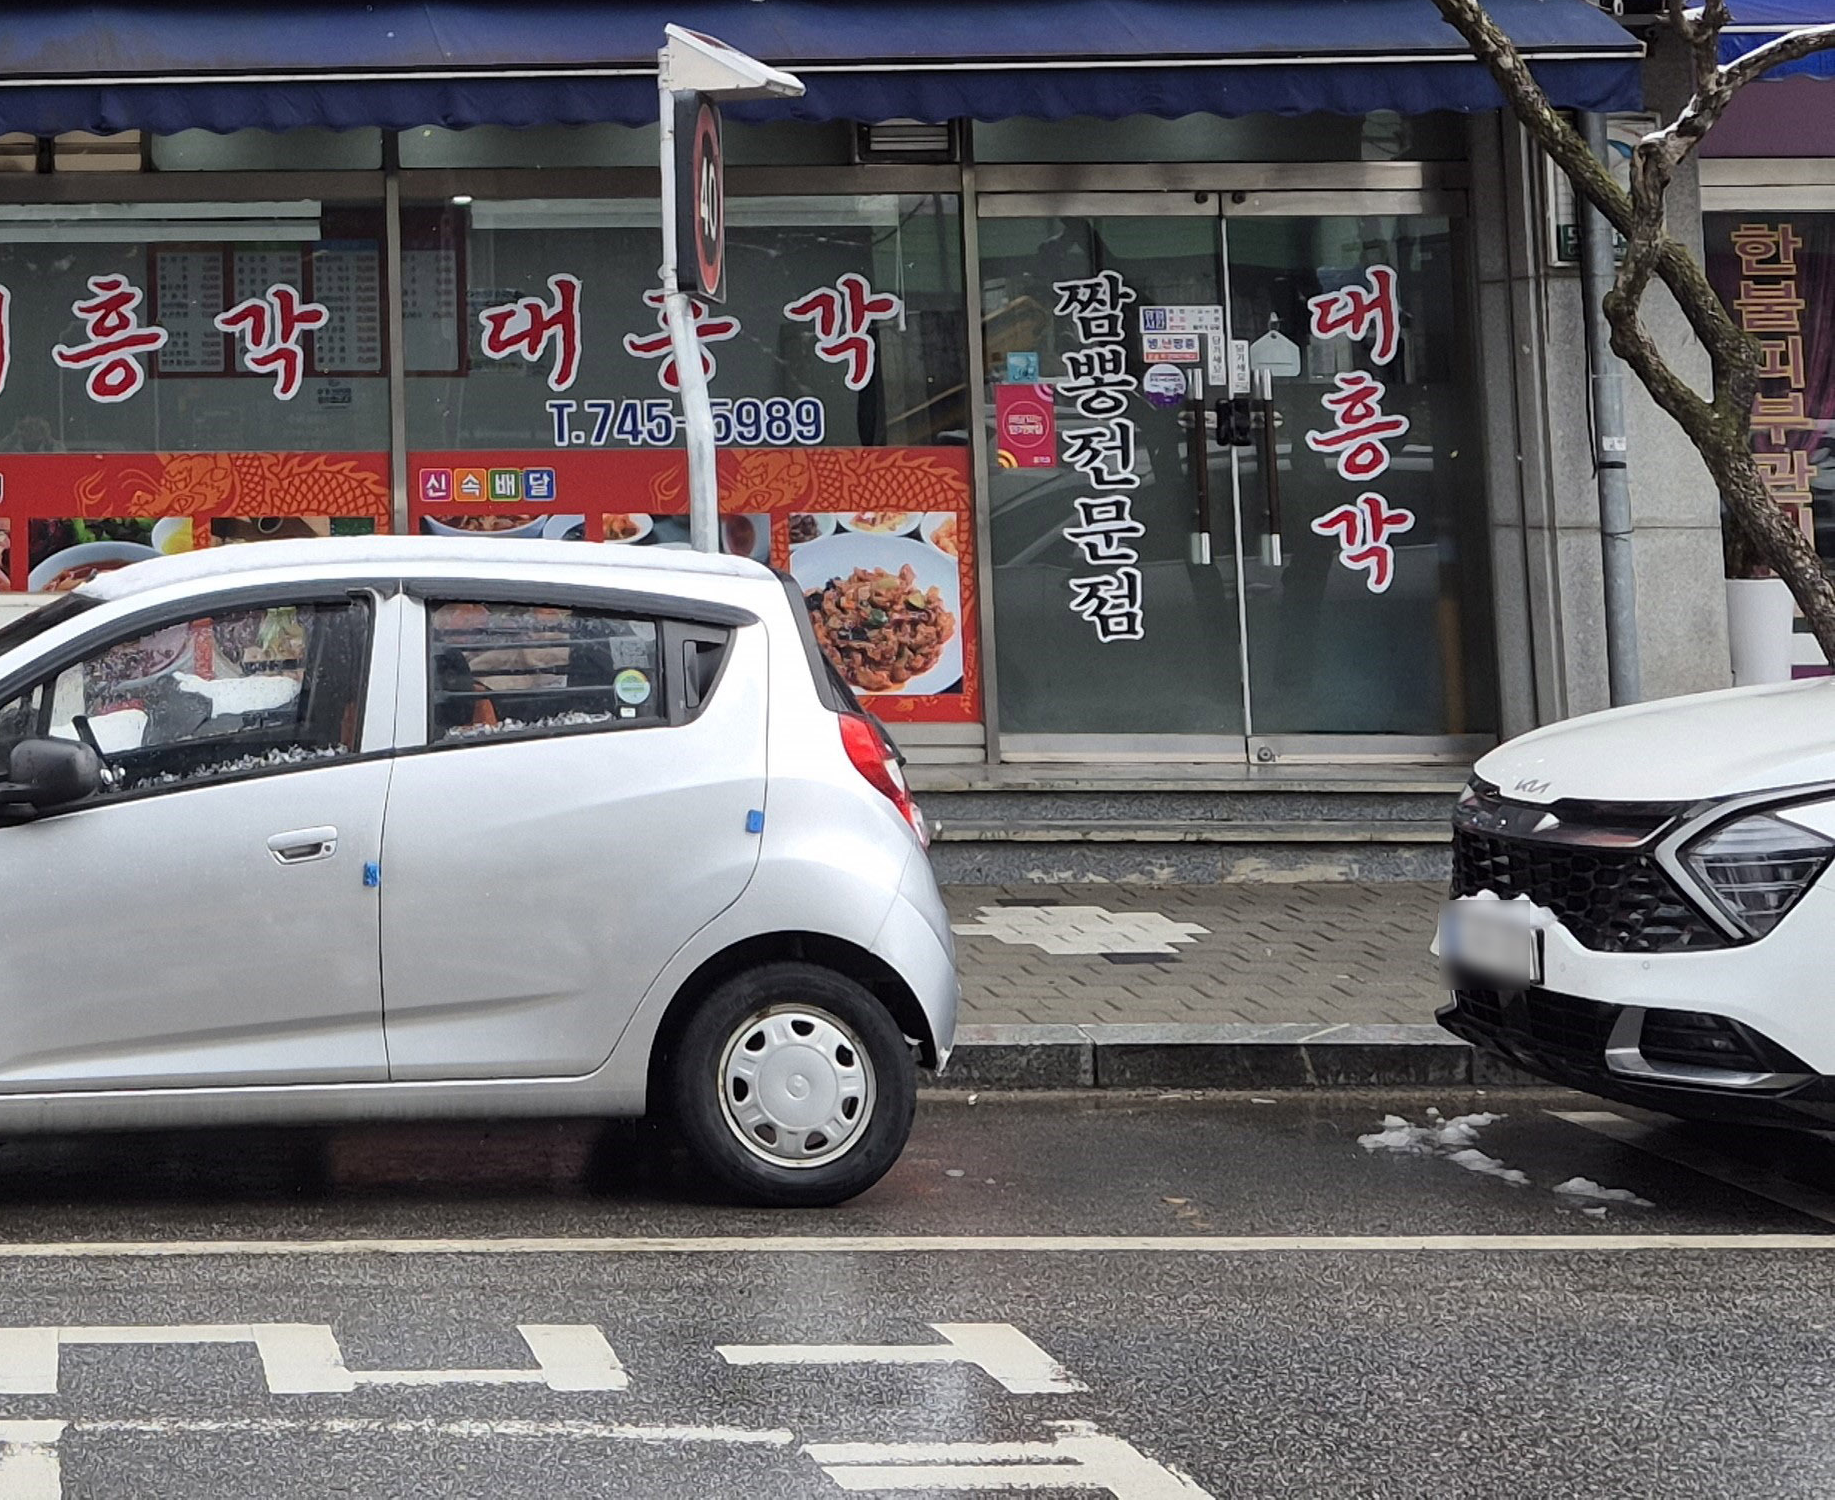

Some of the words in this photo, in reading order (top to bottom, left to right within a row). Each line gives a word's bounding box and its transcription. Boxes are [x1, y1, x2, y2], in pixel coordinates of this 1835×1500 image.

[699, 156, 718, 242] 40
[423, 471, 553, 499] 신속배달
[1053, 269, 1146, 644] 짬뽕전문점
[1304, 264, 1416, 595] 대흥각
